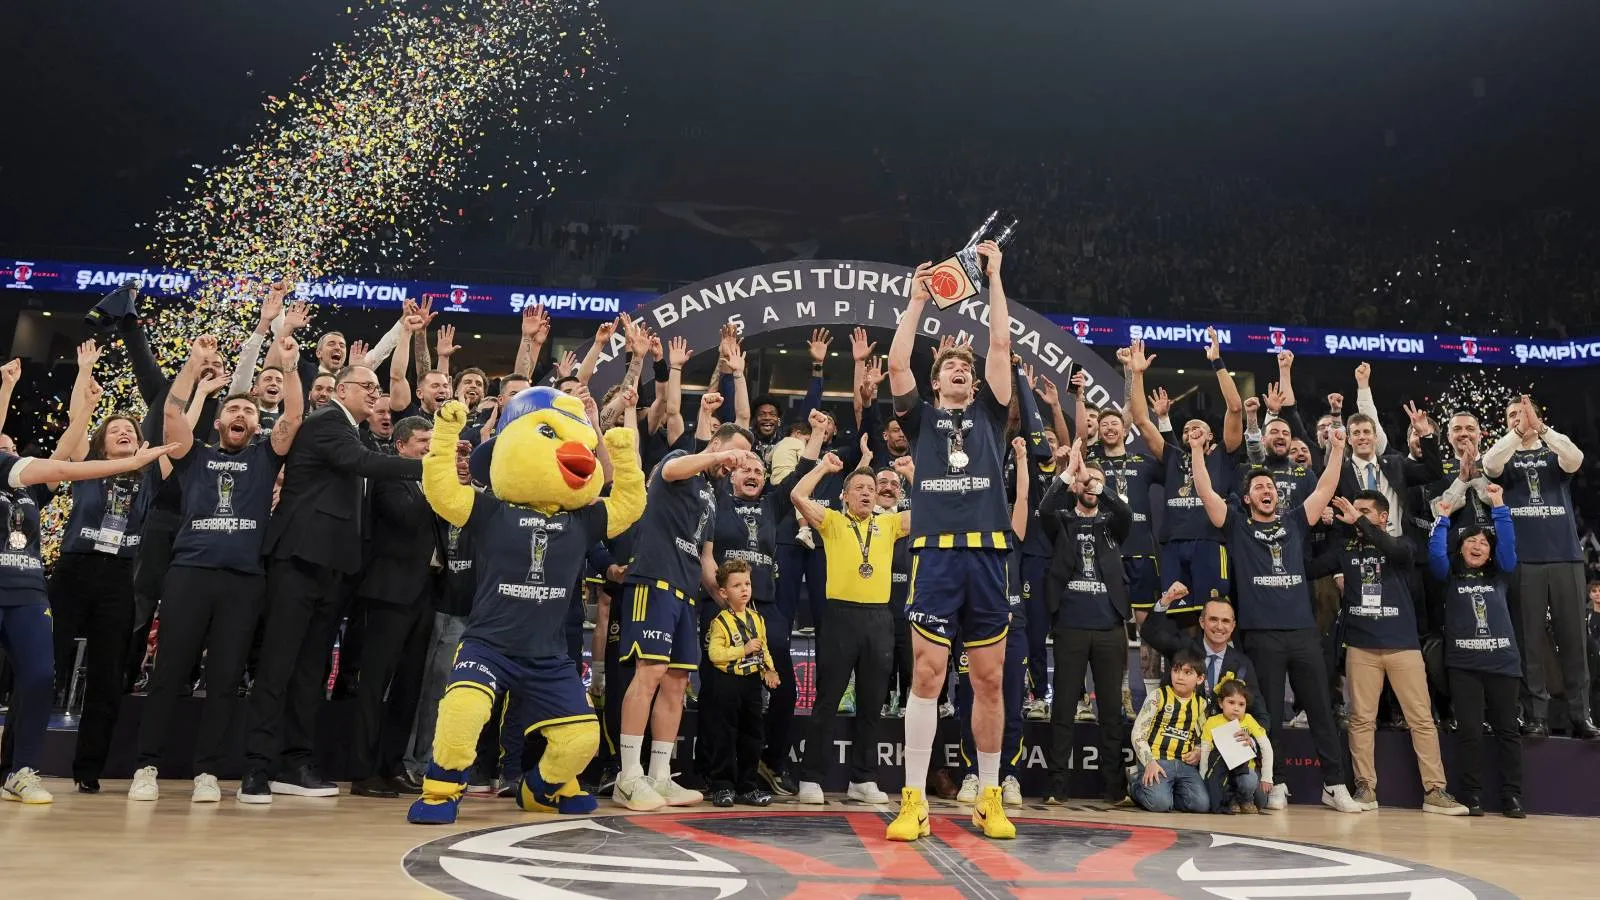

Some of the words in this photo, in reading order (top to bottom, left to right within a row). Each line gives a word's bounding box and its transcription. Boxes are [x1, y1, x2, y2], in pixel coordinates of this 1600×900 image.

[510, 292, 620, 313] ŞAMPİYON
[652, 268, 802, 329] BANKASI
[810, 263, 936, 305] TÜRKİ
[1324, 333, 1424, 354] ŞAMPİYON
[1514, 341, 1600, 363] ŞAMPİYO
[207, 460, 248, 471] CHAMPIONS
[920, 477, 971, 495] FENERBAHÇE
[972, 477, 991, 490] BEKO
[1510, 506, 1550, 519] FENERBAHÇE
[192, 518, 238, 533] FENERBAHÇE
[1253, 575, 1292, 589] FENERBAHÇE
[498, 583, 549, 603] FENERBAHÇE
[642, 629, 663, 640] YKT
[1455, 639, 1498, 652] FENERBAHÇE
[455, 660, 477, 671] YKT
[1284, 757, 1321, 767] KUPA
